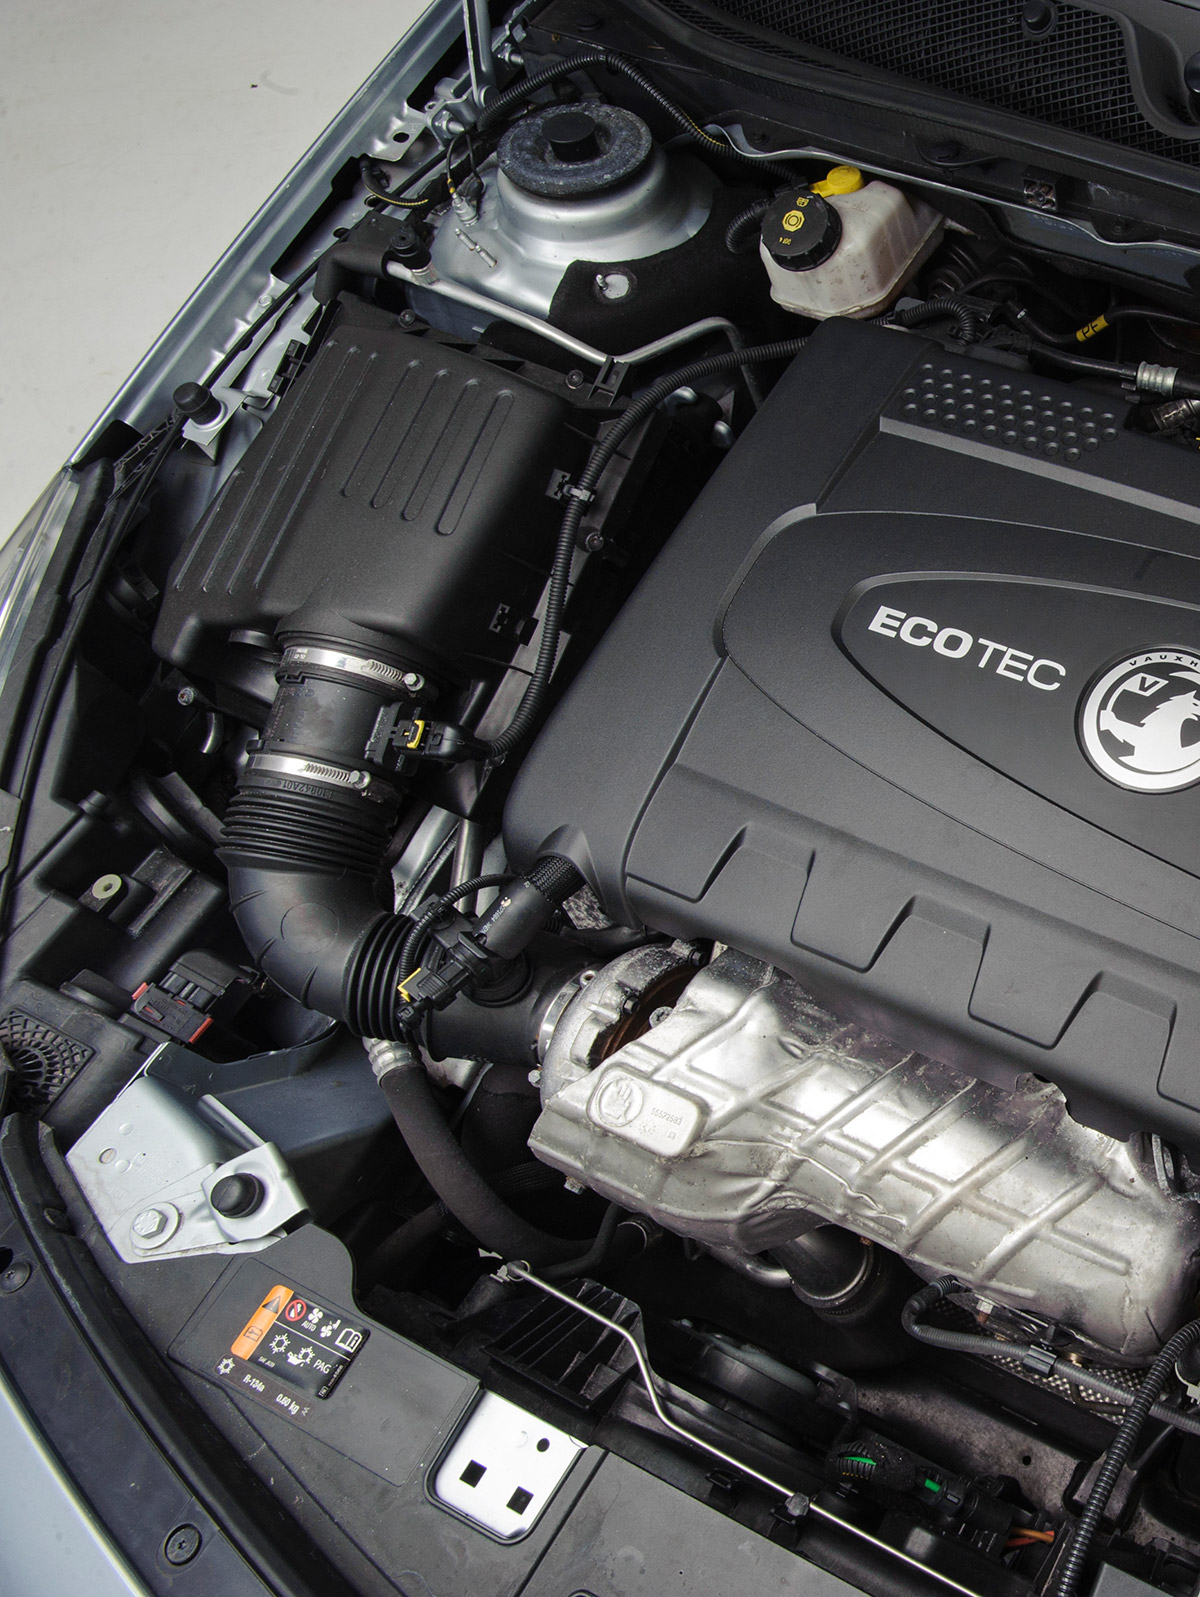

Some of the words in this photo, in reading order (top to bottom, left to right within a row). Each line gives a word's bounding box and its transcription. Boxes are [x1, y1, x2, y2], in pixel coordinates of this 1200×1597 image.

[868, 605, 1066, 691] ECOTEC
[1138, 676, 1160, 693] V
[301, 1320, 317, 1332] AUTO
[313, 1359, 332, 1374] PAG
[242, 1374, 266, 1392] R-134a
[276, 1393, 291, 1407] 0.60
[288, 1402, 300, 1415] kg
